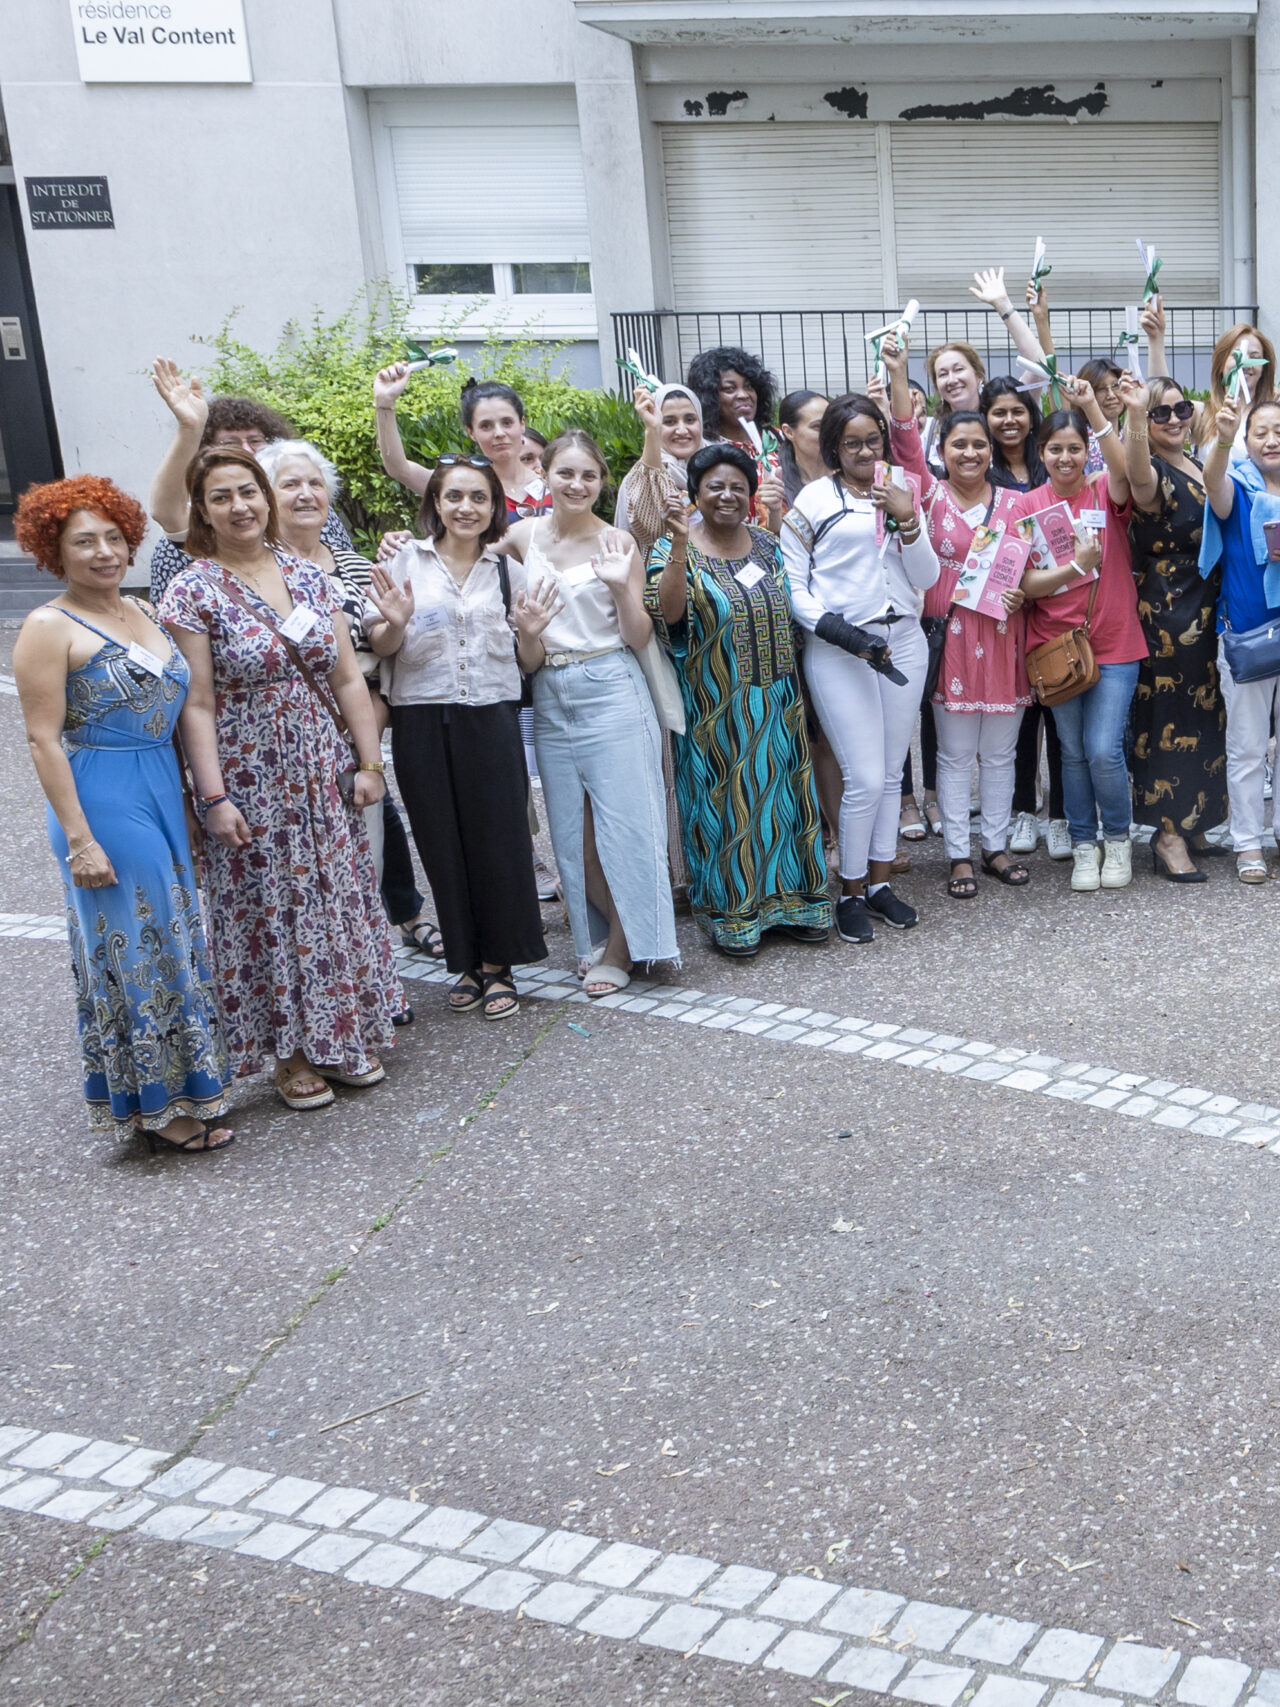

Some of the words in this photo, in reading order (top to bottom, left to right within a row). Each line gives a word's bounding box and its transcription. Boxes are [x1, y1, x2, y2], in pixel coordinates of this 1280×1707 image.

[78, 0, 172, 19] résidence
[82, 26, 108, 44] Le
[112, 26, 145, 45] Val
[151, 26, 236, 45] Content
[32, 184, 103, 197] INTERDIT
[61, 199, 80, 209] DE
[31, 210, 113, 223] STATIONNER
